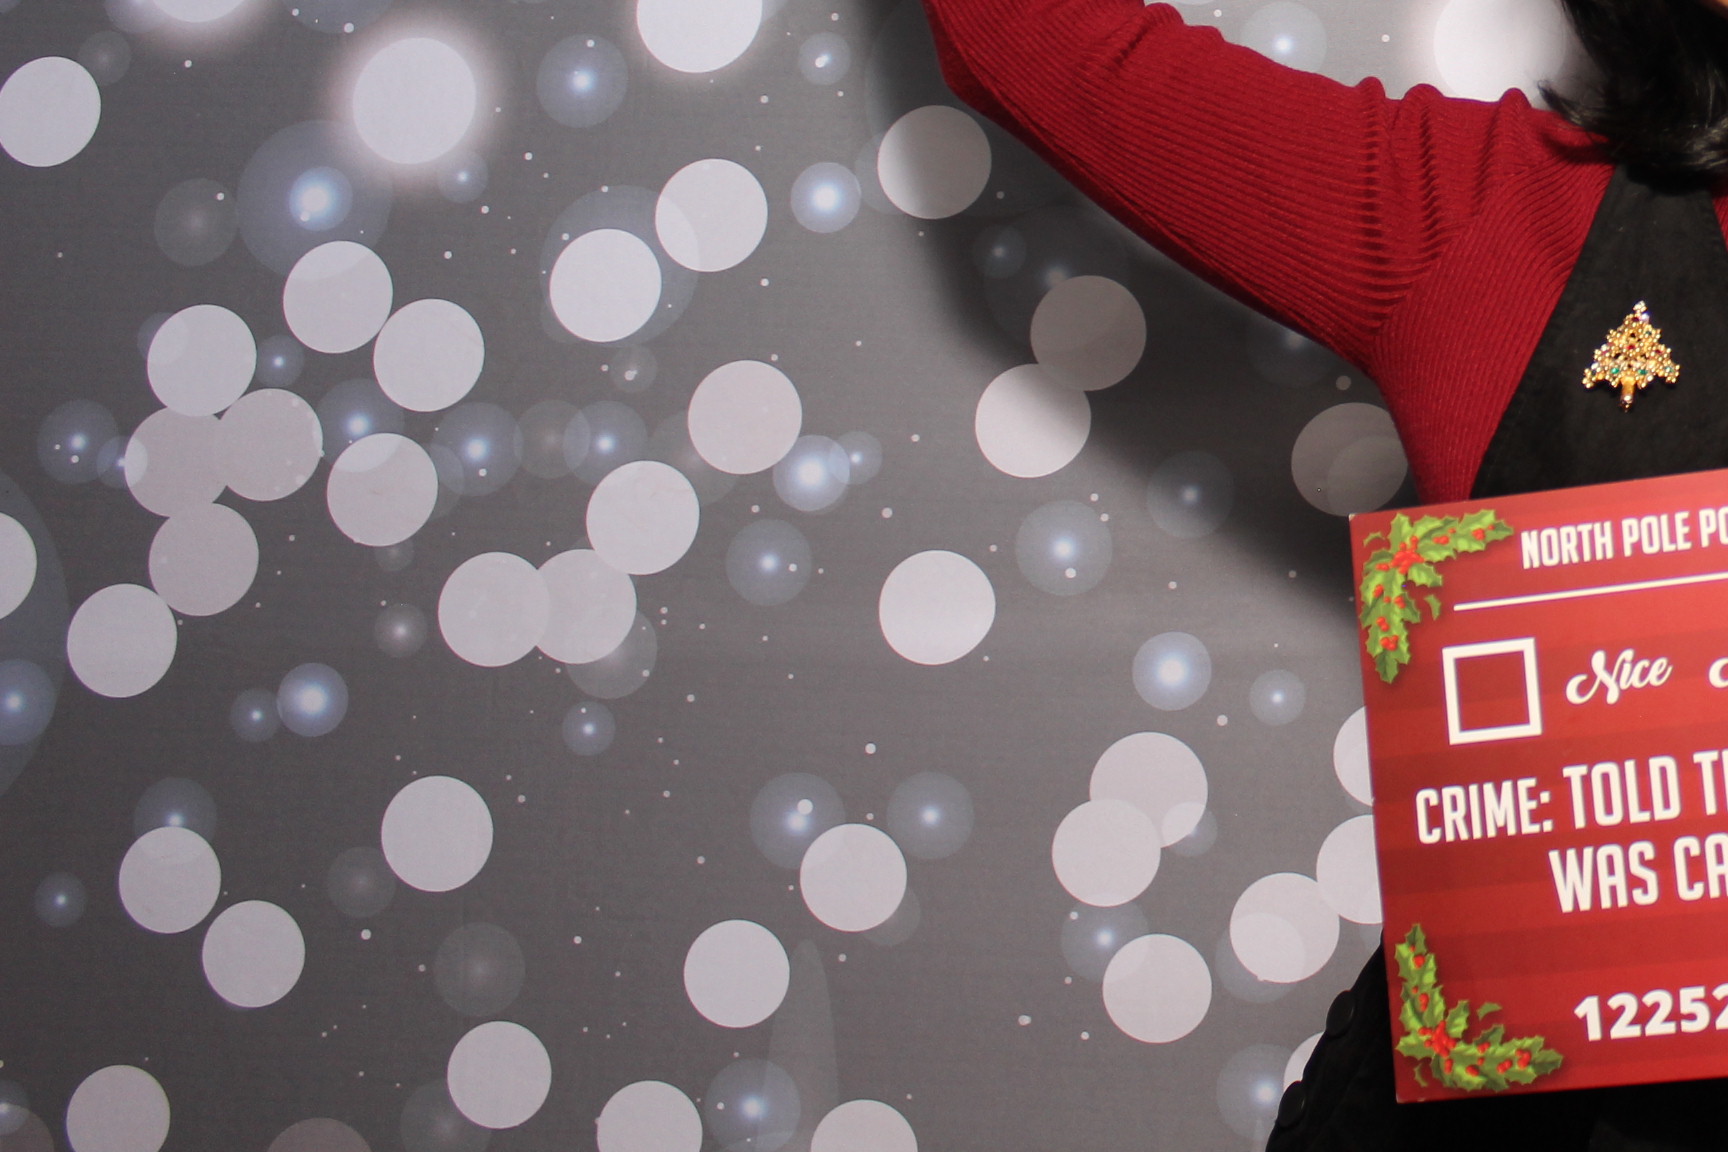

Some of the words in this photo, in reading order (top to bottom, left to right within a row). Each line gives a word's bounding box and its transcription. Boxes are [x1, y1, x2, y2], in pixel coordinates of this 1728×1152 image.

[1521, 521, 1614, 569] NORTH
[1622, 510, 1692, 555] POLE
[1565, 648, 1673, 705] Nice
[1415, 777, 1553, 844] CRIME:
[1562, 755, 1681, 829] TOLD
[1548, 843, 1659, 913] WAS
